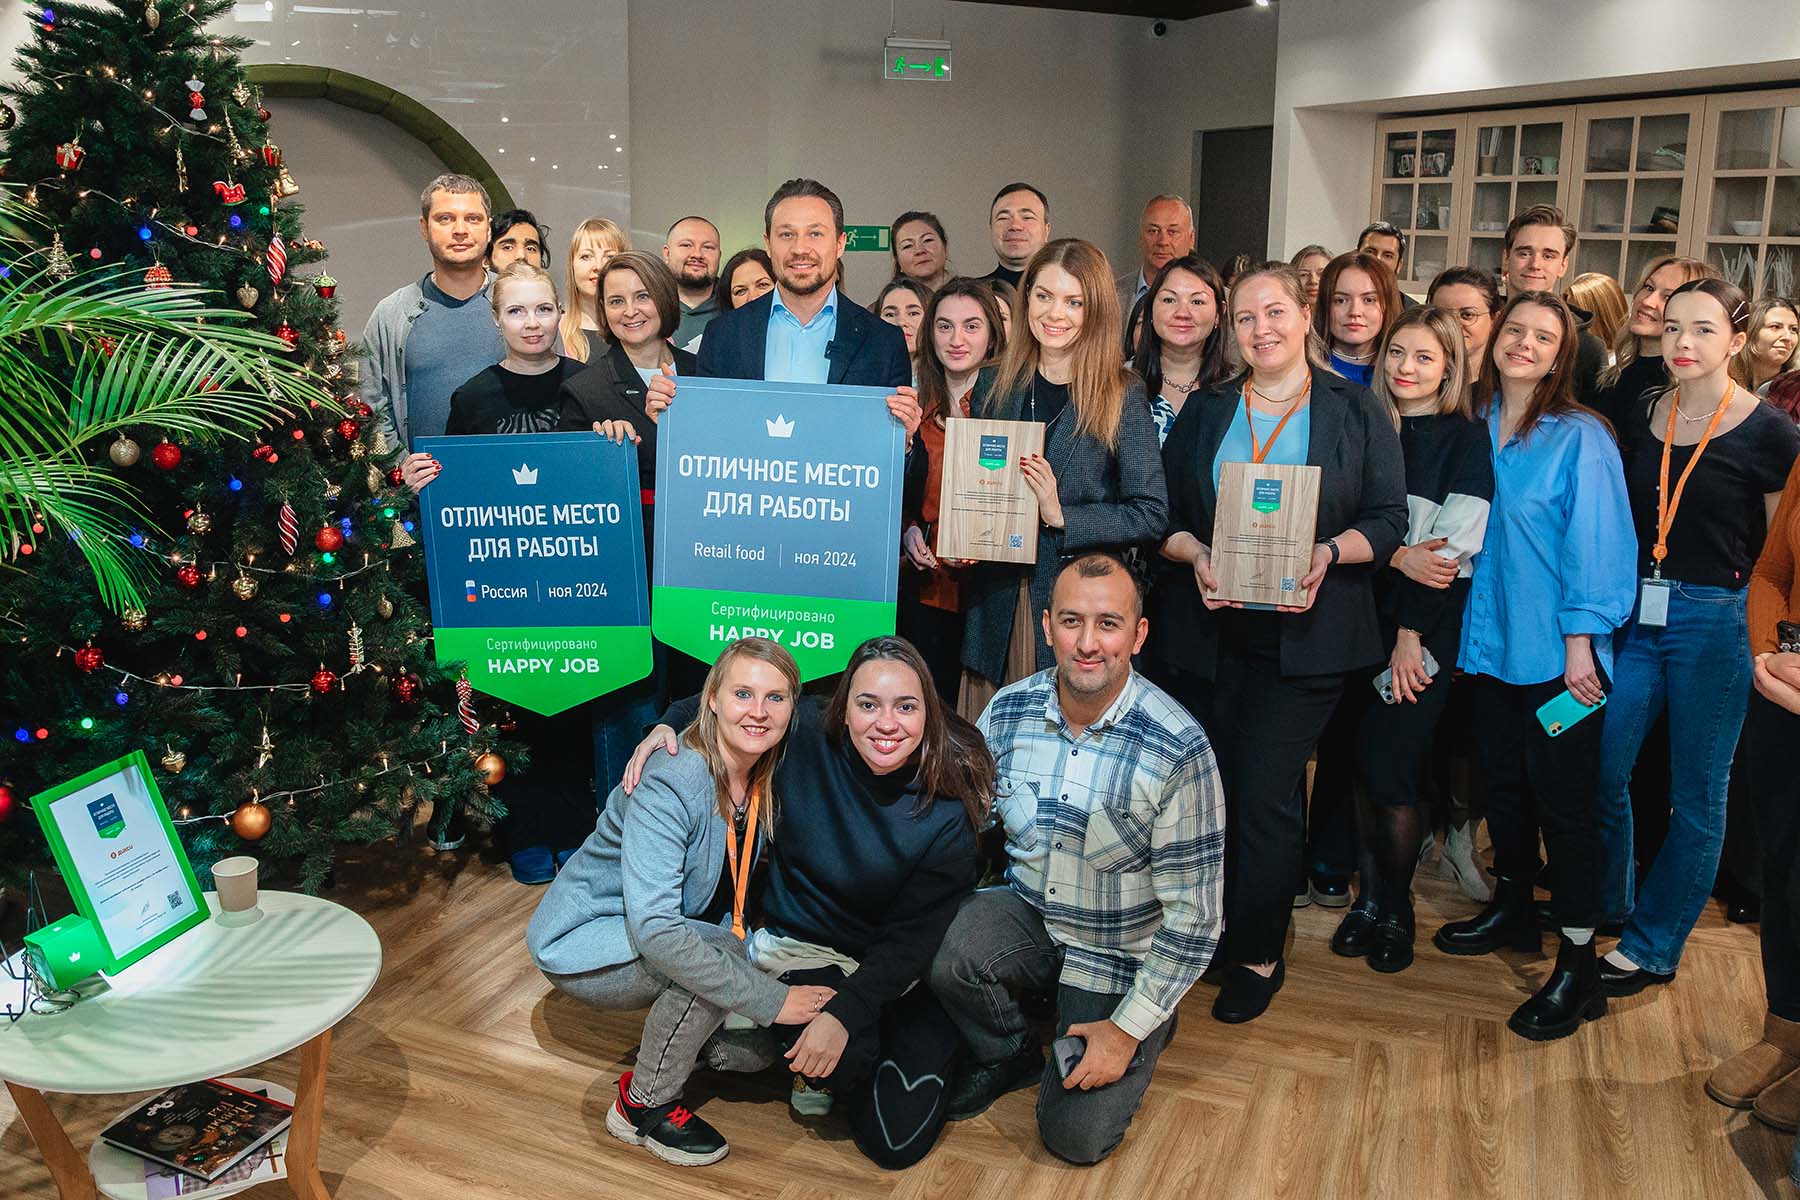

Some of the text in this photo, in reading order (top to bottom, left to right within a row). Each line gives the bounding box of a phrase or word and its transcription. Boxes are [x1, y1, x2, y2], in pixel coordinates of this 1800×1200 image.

[678, 454, 880, 488] ОТЛИЧНОЕ МЕСТО
[441, 503, 620, 528] ОТЛИЧНОЕ МЕСТО
[703, 491, 850, 522] ДЛЯ РАБОТЫ
[468, 536, 599, 562] ДЛЯ РАБОТЫ
[694, 543, 857, 567] Retail food ноя 2024
[481, 583, 608, 600] Россия ноя 2024
[711, 601, 835, 624] Сертифицировано
[487, 638, 598, 654] Сертифицировано
[709, 624, 835, 649] HAPPY JOB
[488, 658, 600, 674] HAPPY JOB
